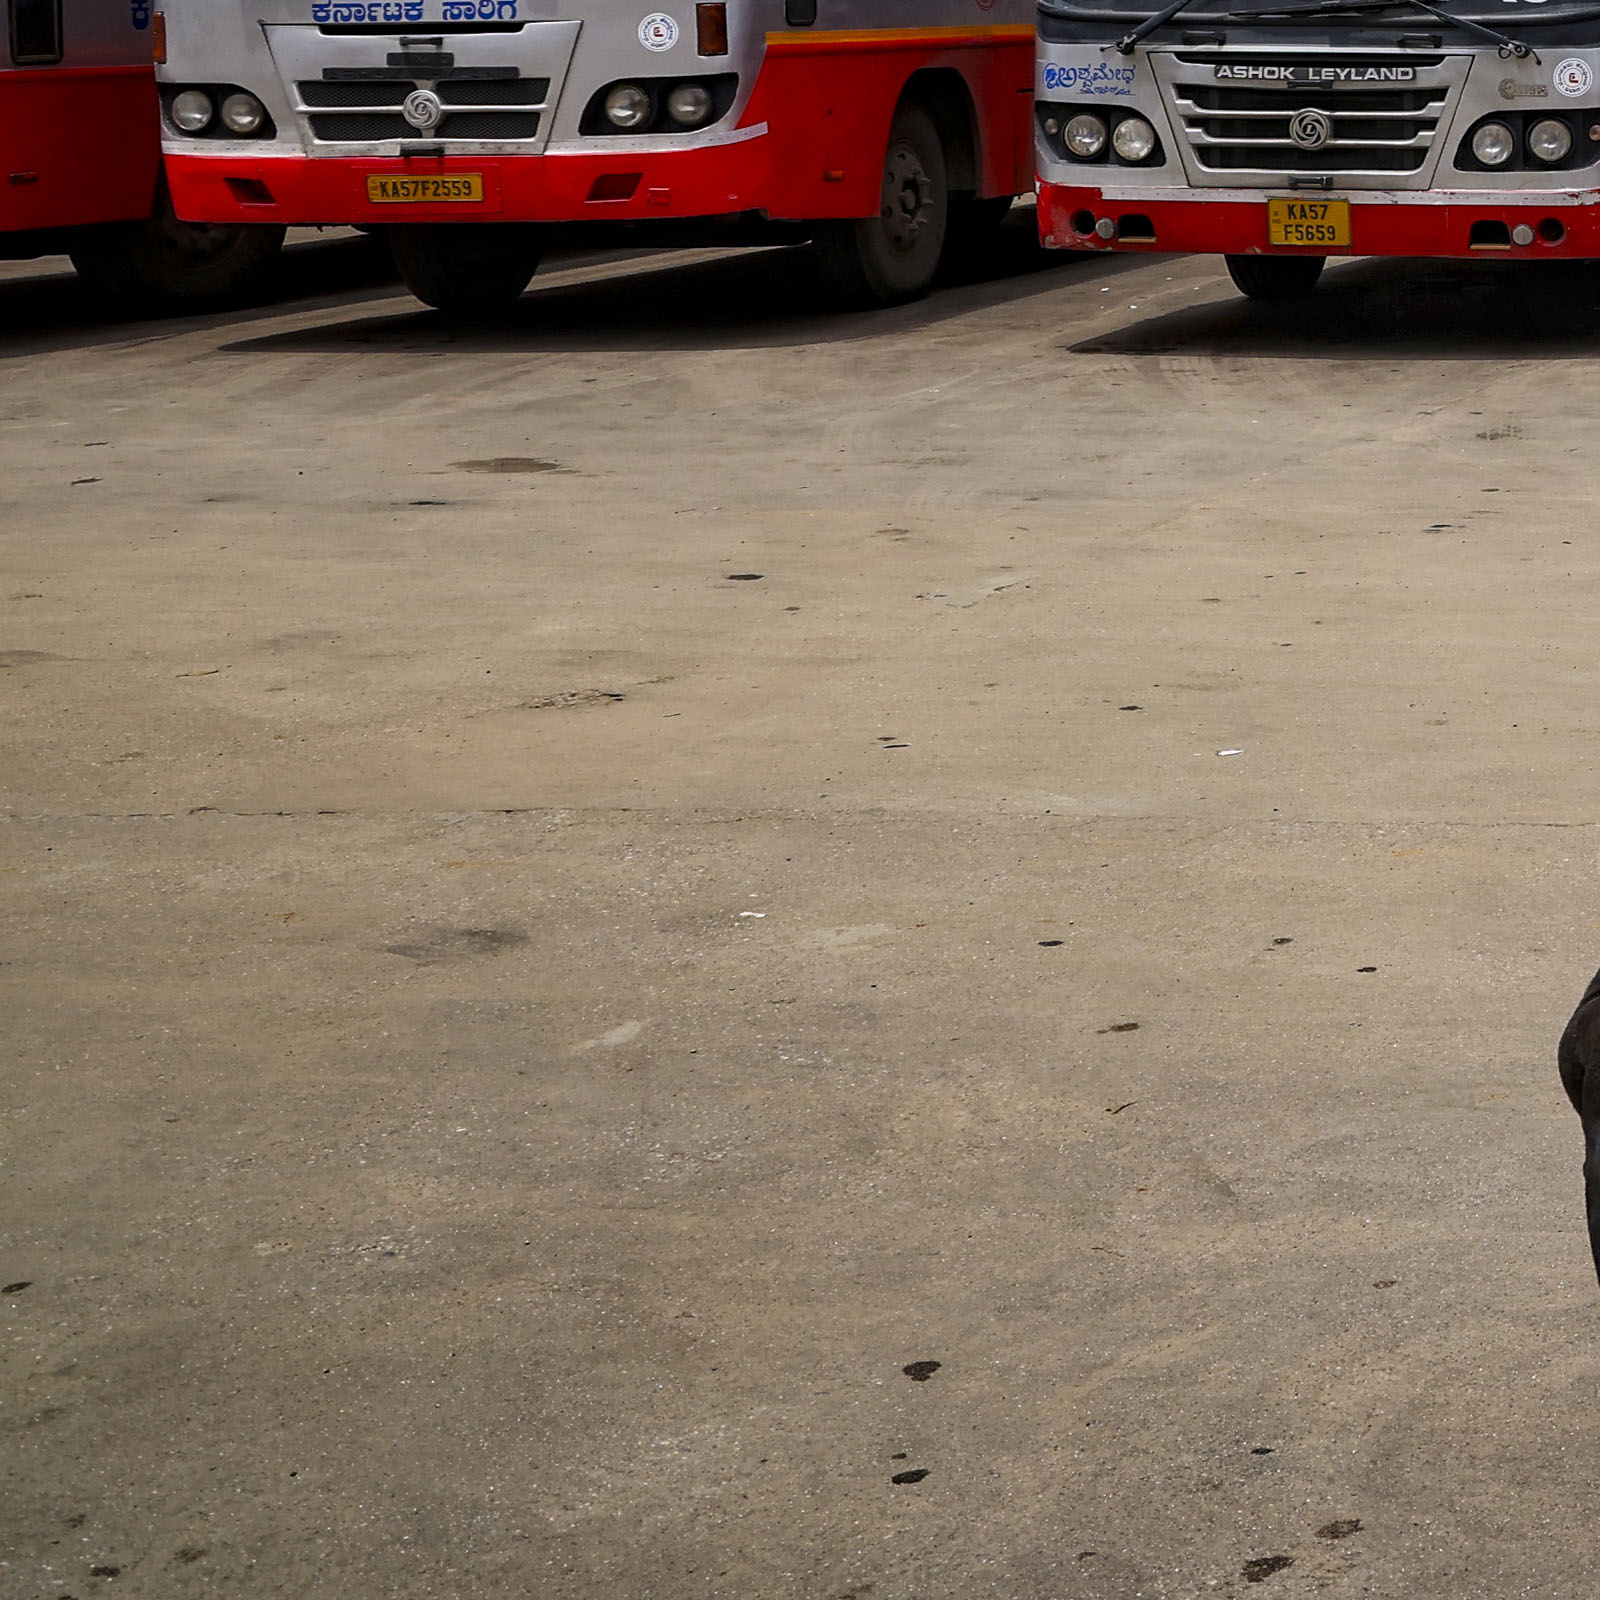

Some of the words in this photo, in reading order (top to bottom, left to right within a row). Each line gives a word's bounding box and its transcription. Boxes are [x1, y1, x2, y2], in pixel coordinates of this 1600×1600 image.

[1216, 65, 1295, 79] ASHOK
[1308, 67, 1413, 80] LEYLAND
[379, 179, 471, 197] KA57F2559
[1287, 204, 1328, 220] KA57
[1284, 225, 1336, 241] F5659
